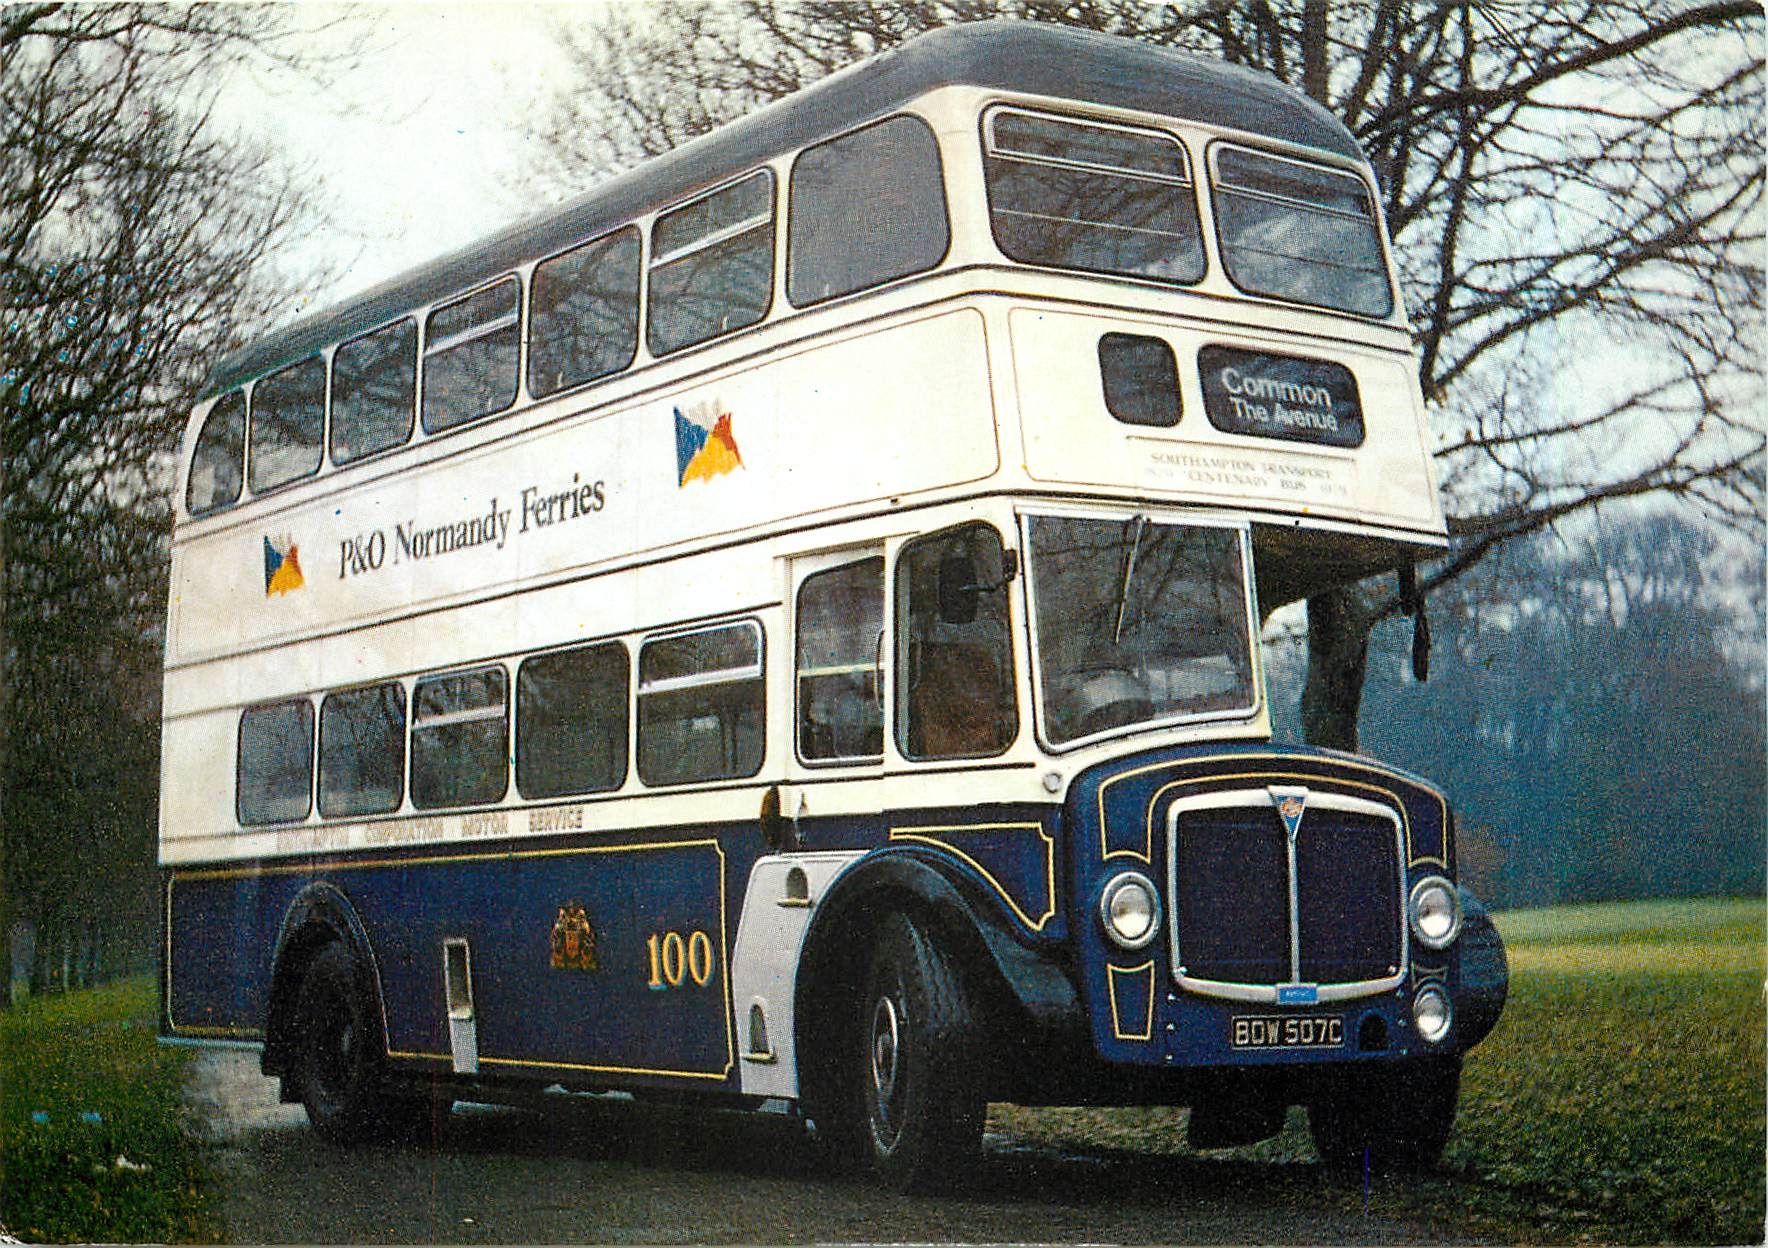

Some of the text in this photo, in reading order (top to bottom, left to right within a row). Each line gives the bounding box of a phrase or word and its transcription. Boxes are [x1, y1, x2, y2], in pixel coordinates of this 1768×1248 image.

[1221, 366, 1332, 411] Common
[1229, 396, 1339, 432] The Avenue
[1151, 452, 1332, 480] SOUTHAMPTON TRANSPORT
[1188, 469, 1268, 487] CENTENARY
[1280, 480, 1306, 491] BUS
[339, 472, 606, 580] P&O Normandy Ferries
[462, 813, 509, 836] MOTOR
[529, 805, 584, 833] SERVICE
[647, 931, 714, 990] 100
[1235, 1018, 1342, 1045] BOW 507C
